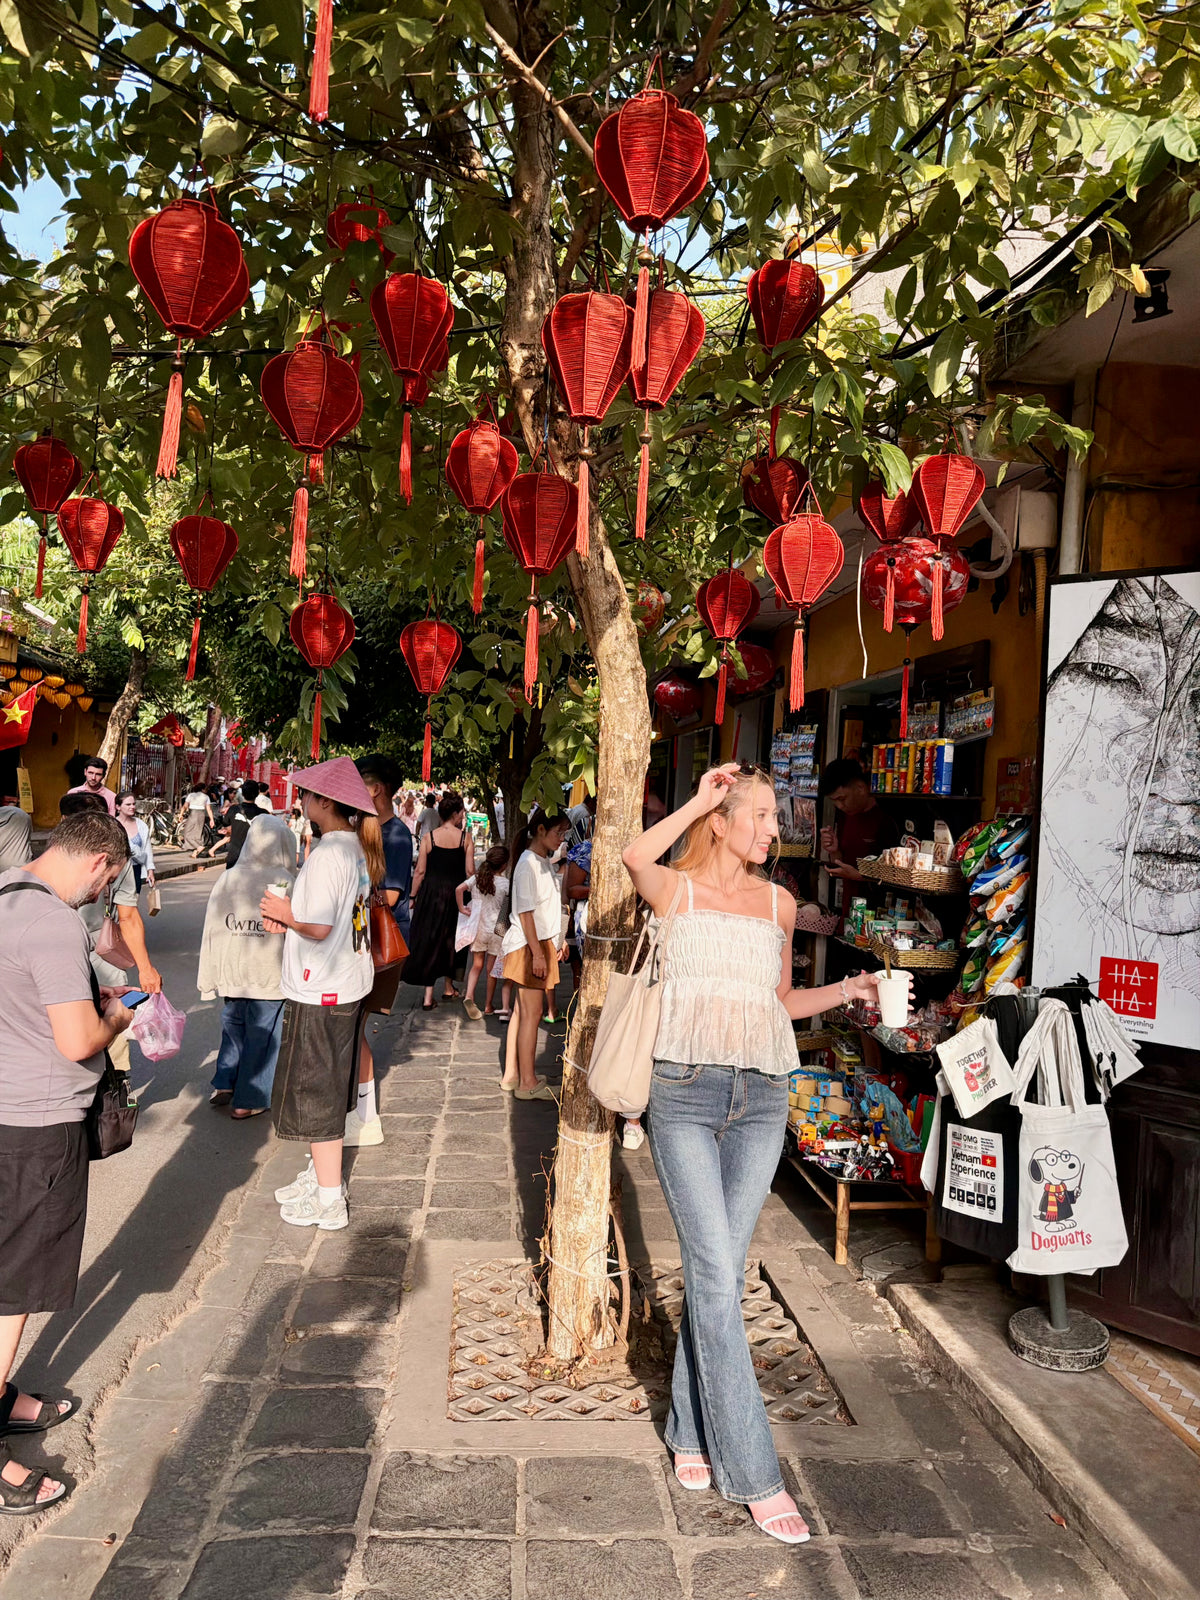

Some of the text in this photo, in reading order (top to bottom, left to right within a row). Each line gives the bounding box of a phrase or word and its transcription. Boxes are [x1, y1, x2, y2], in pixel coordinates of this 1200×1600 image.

[1119, 1016, 1154, 1030] Everything
[956, 1046, 988, 1068] TOGETHER
[982, 1078, 998, 1094] EVER
[962, 1133, 979, 1144] OMG
[951, 1147, 982, 1165] Vietnam
[950, 1158, 996, 1181] Experience
[1031, 1229, 1093, 1253] Dogwarts
